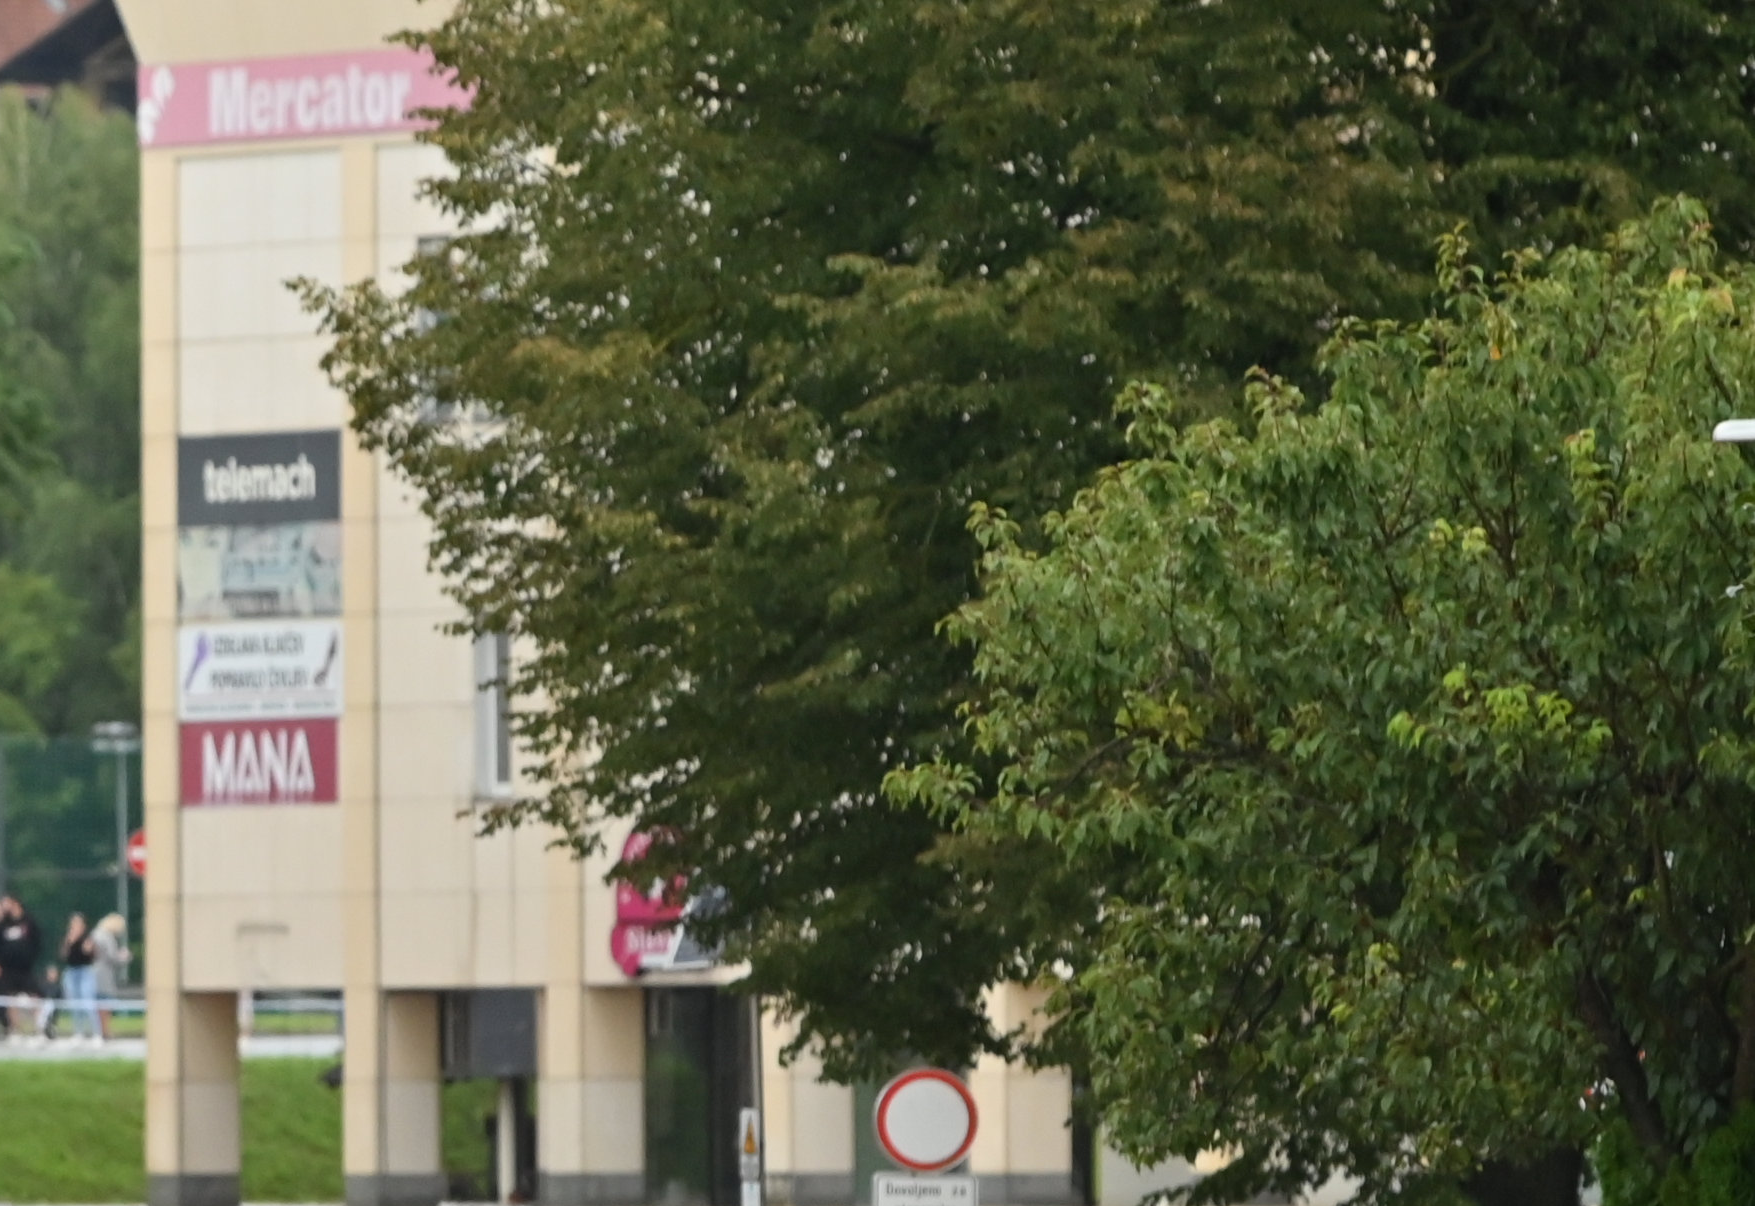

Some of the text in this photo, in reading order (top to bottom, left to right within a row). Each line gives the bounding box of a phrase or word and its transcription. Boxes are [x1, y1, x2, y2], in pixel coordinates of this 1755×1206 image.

[207, 65, 413, 136] Mercator
[202, 452, 317, 504] telemach
[201, 728, 316, 794] MANA
[886, 1182, 942, 1198] Dovoljeno
